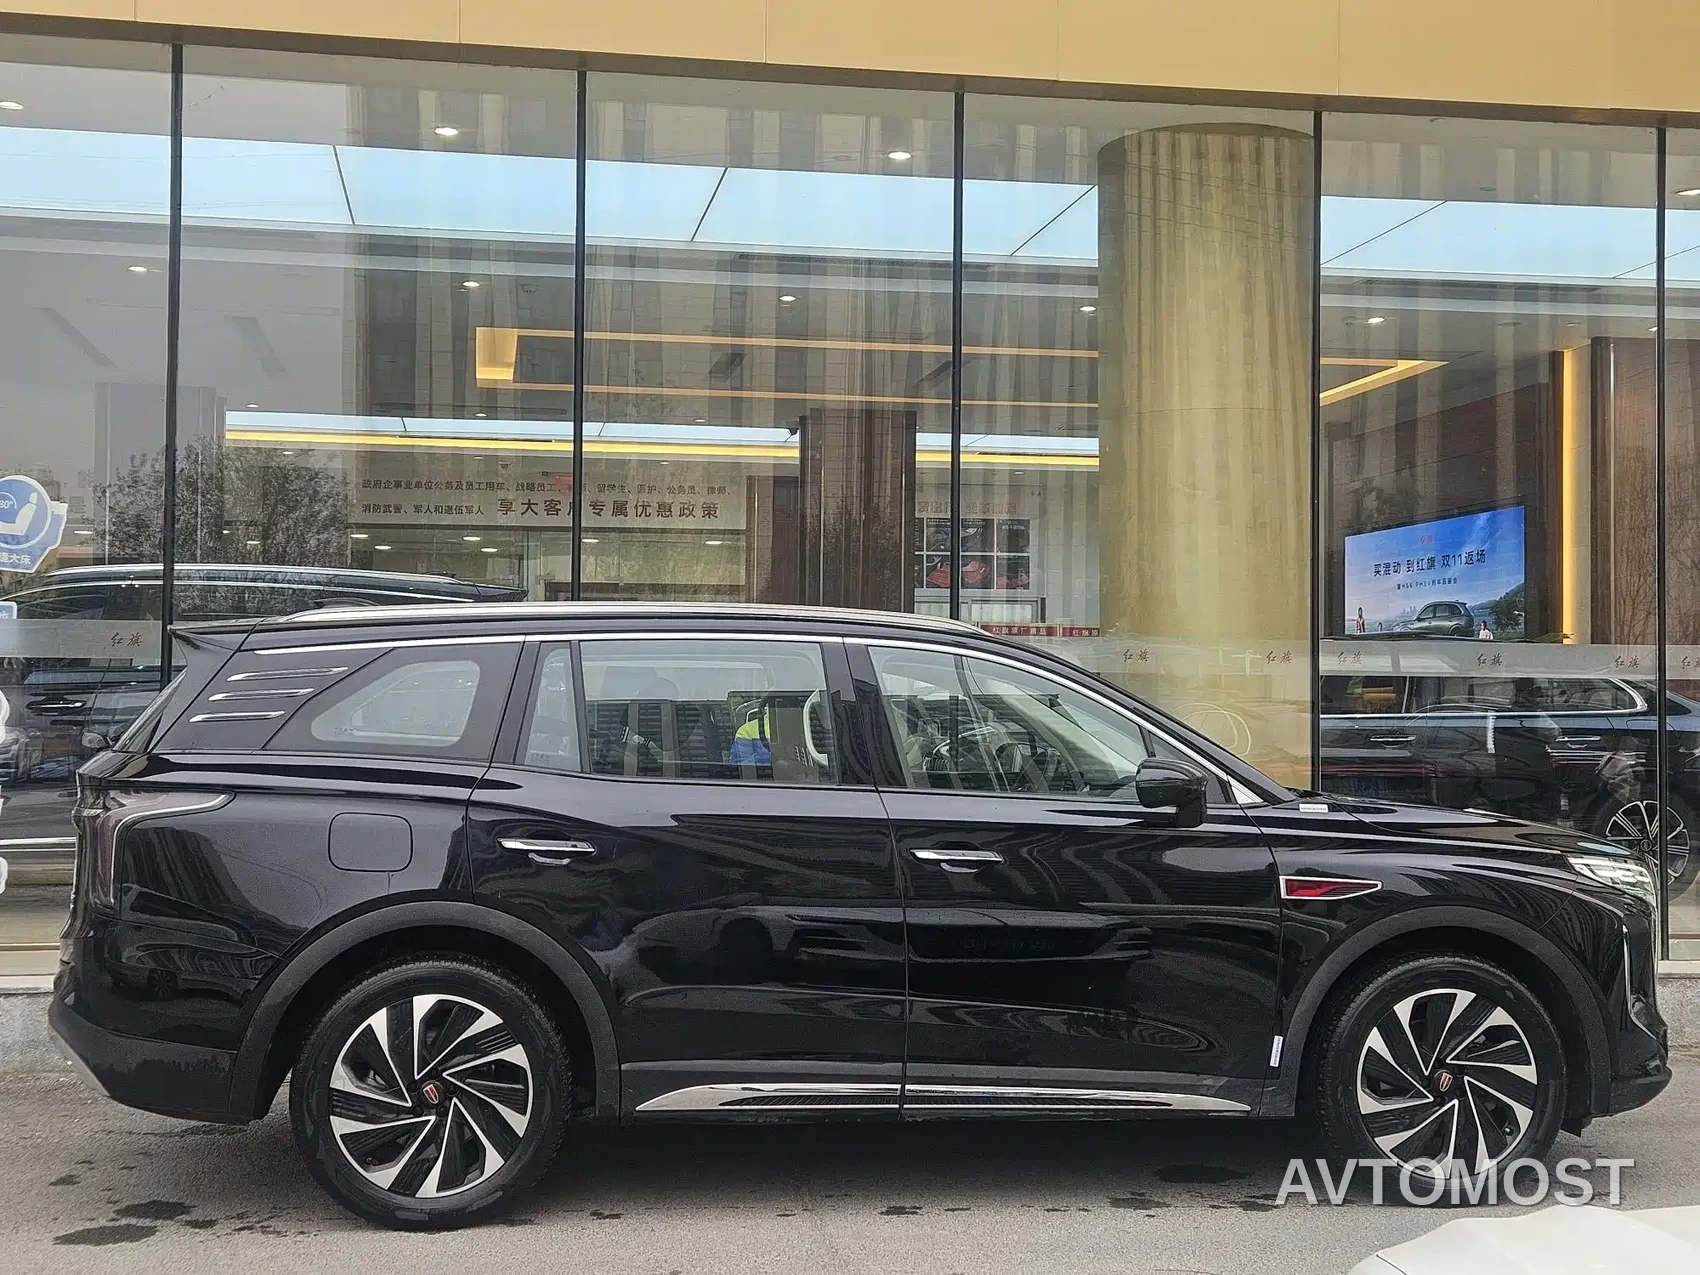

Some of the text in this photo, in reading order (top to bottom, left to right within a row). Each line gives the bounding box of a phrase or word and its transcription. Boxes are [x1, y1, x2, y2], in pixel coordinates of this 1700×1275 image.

[362, 479, 731, 496] 政府企事业单位公务及员工用车、战略员工、、留学生、医护、公务员、律师、
[497, 498, 720, 520] 享大客专属优惠政策
[1373, 548, 1487, 577] 买混动 到红旗 双11返场
[110, 632, 142, 647] 红旗
[1123, 649, 1150, 663] 红旗
[1266, 651, 1293, 664] 红旗
[1336, 651, 1362, 665] 红旗
[1476, 652, 1503, 666] 红旗
[1614, 655, 1640, 669] 红旗
